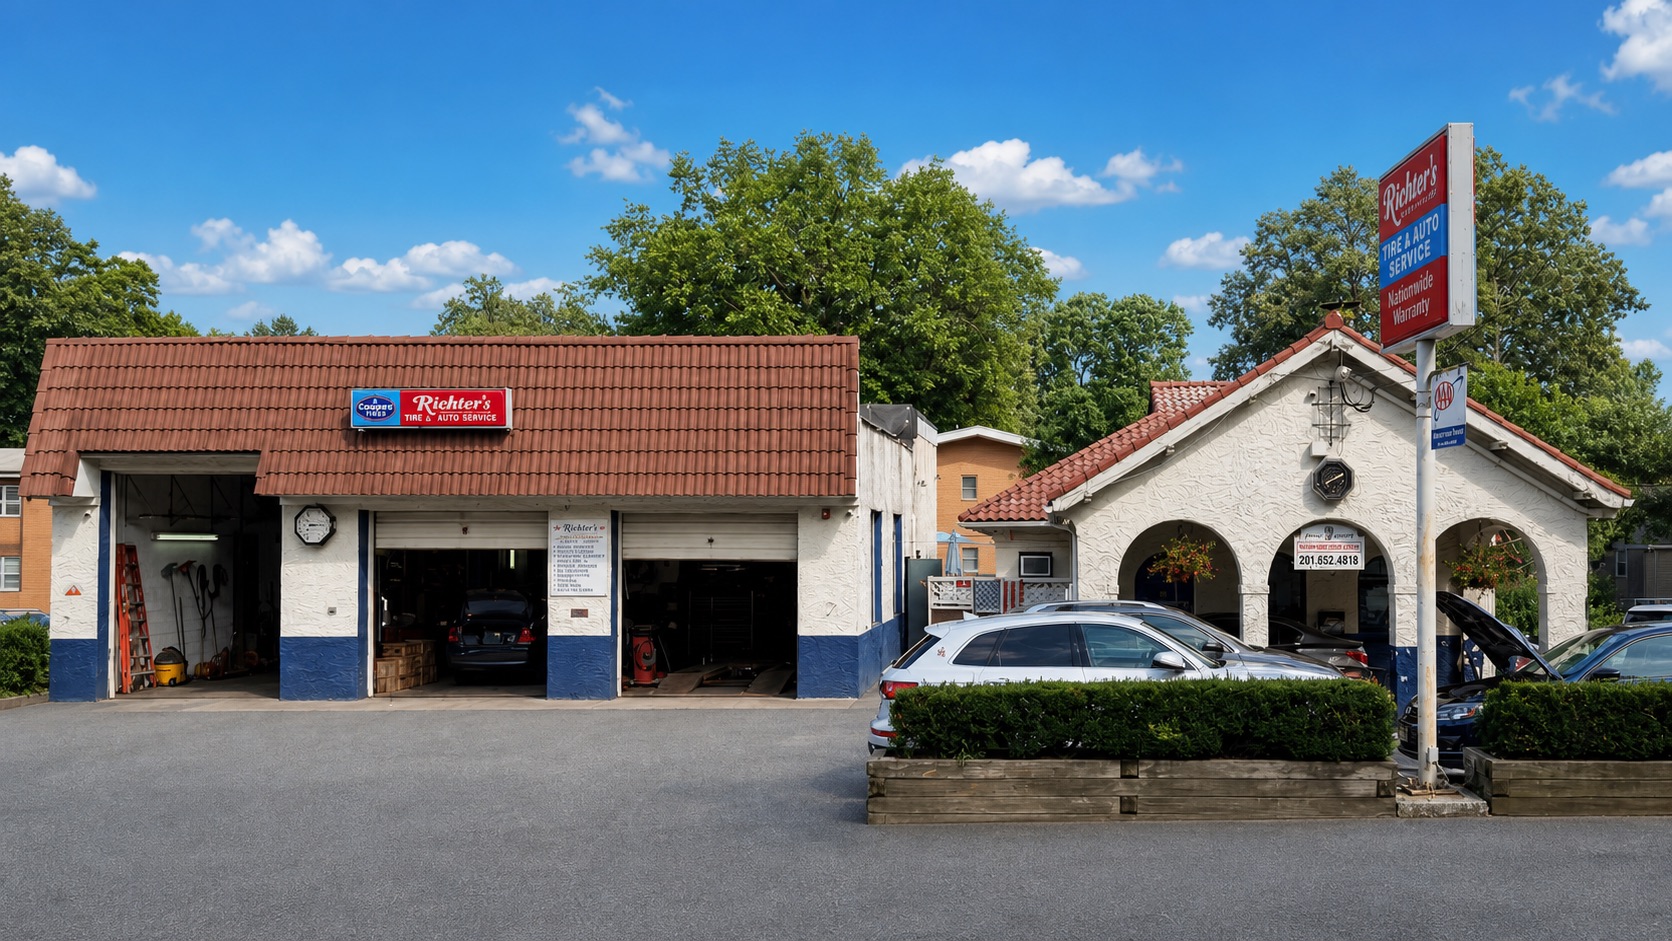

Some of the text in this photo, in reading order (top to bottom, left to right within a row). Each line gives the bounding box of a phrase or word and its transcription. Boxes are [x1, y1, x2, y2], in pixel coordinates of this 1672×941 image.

[1383, 153, 1438, 227] Richter's
[1382, 235, 1403, 262] TIRE
[1412, 213, 1439, 245] AUTO
[1389, 239, 1431, 278] SERVICE
[1388, 270, 1434, 309] Nationwide
[1393, 298, 1430, 326] Warranty
[404, 414, 423, 422] TIRE
[437, 413, 459, 422] AUTO
[462, 413, 497, 422] SERVICE
[412, 394, 491, 416] Richter's
[1298, 555, 1359, 566] 201.652.4818
